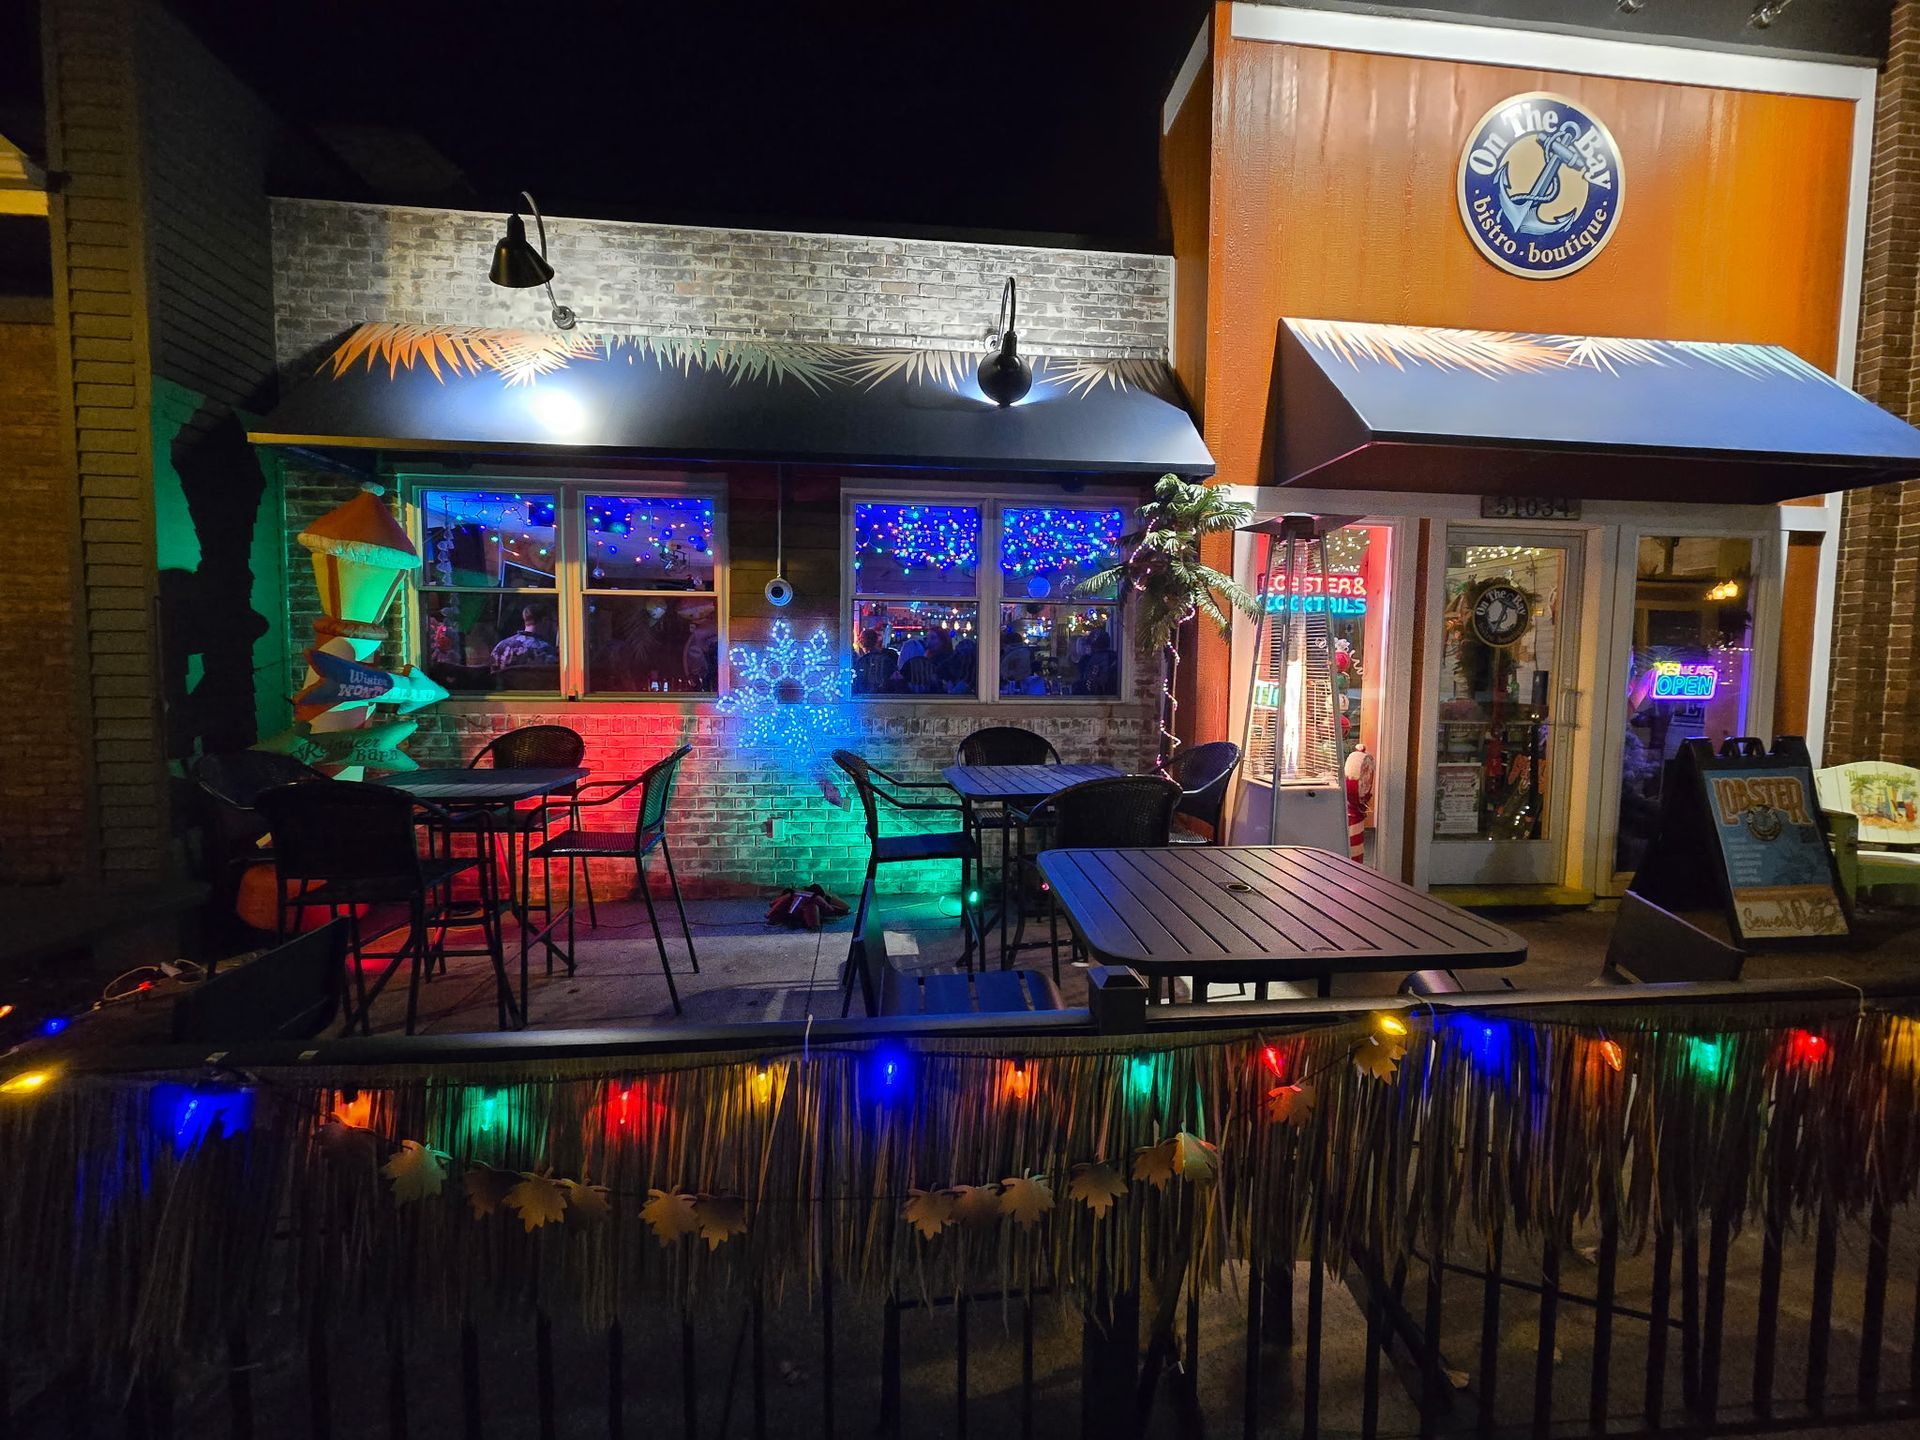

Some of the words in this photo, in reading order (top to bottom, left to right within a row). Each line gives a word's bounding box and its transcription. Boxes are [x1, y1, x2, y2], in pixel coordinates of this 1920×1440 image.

[1469, 131, 1508, 176] On
[1501, 103, 1558, 137] The
[1575, 125, 1612, 190] Bay
[1473, 194, 1517, 254] bistro
[1527, 206, 1608, 263] boutique
[1476, 601, 1489, 616] On
[1485, 590, 1506, 601] The
[1512, 594, 1526, 615] Bay
[350, 669, 387, 686] Winter
[1656, 675, 1713, 696] OPEN
[1712, 776, 1813, 827] LOBSTER
